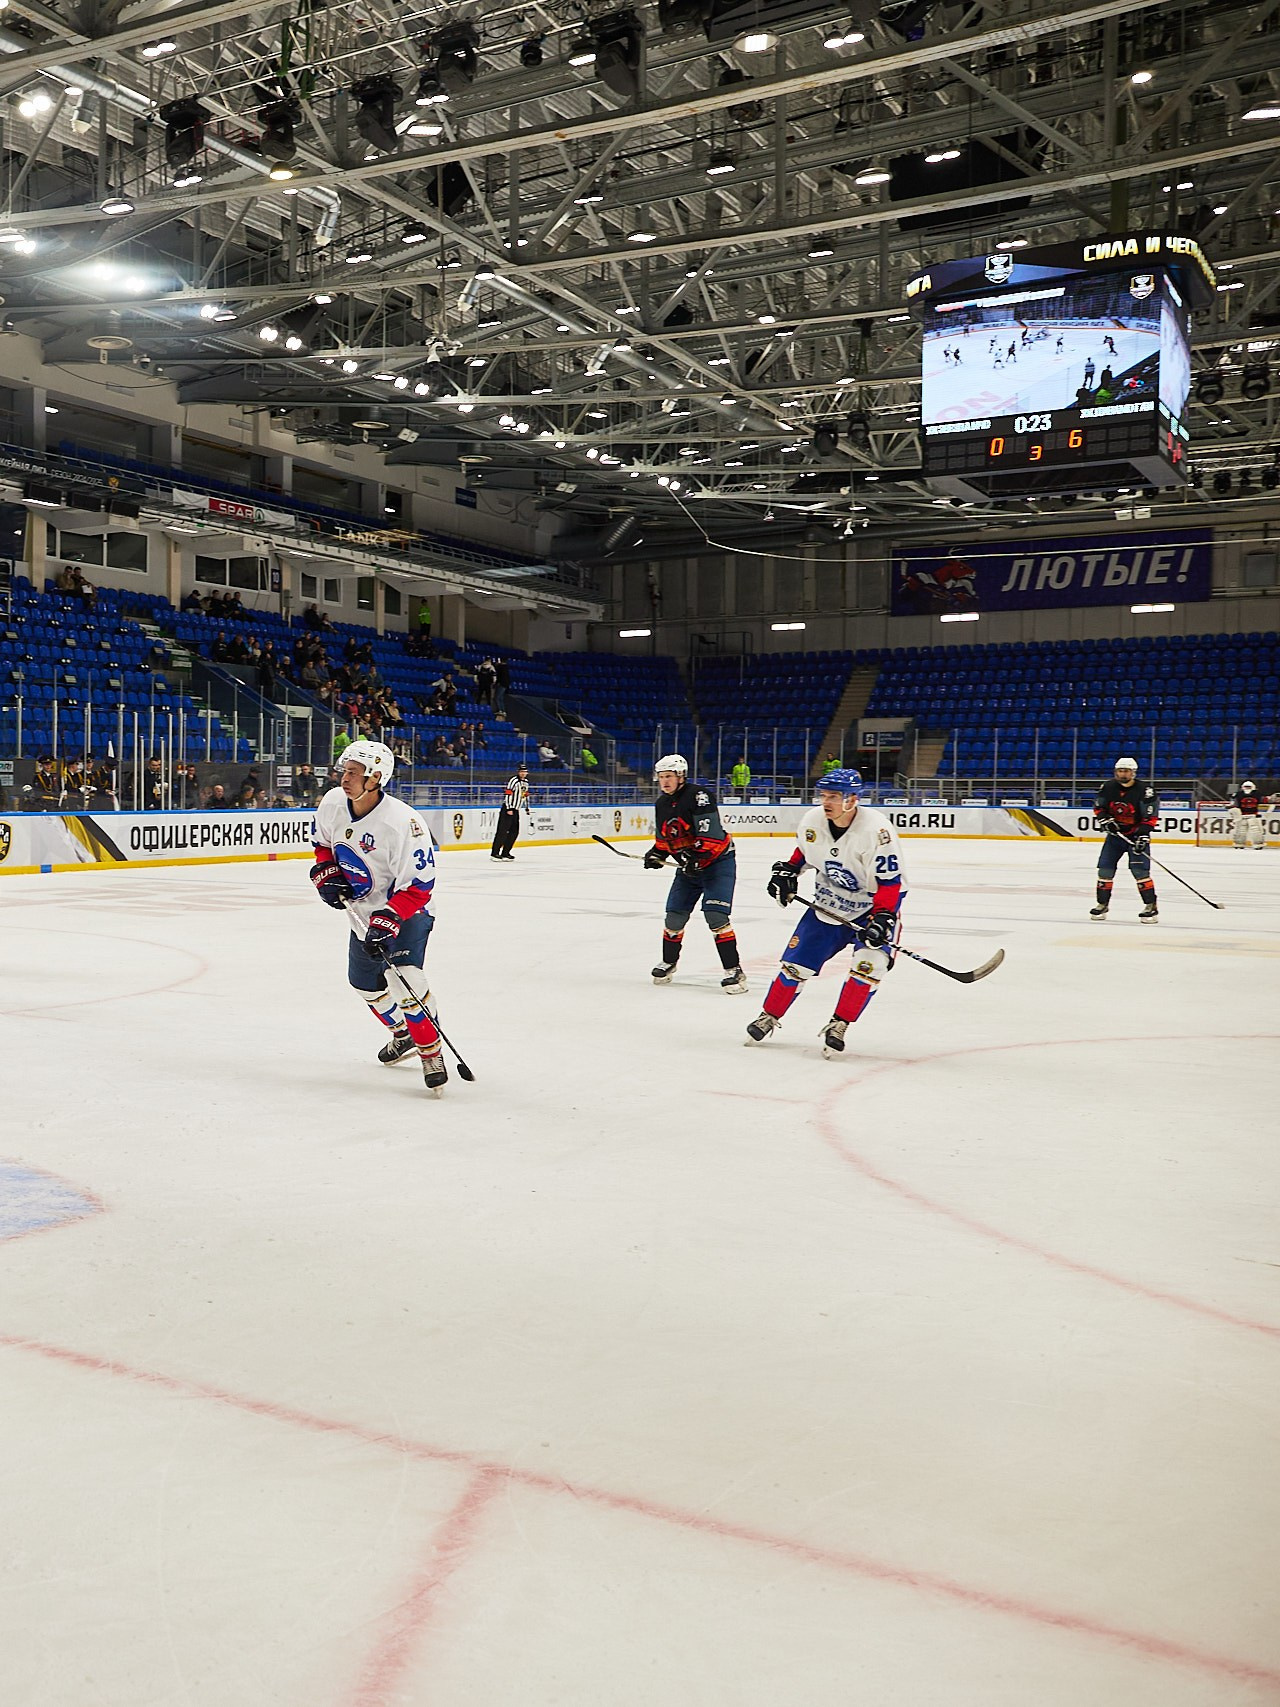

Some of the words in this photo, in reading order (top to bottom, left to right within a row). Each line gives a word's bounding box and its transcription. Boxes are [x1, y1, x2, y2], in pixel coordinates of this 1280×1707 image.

[1083, 238, 1139, 262] СИЛА
[1145, 236, 1161, 253] И
[1014, 414, 1052, 434] 0:23
[990, 437, 1004, 457] 0
[1068, 429, 1083, 448] 6
[1029, 445, 1043, 461] 3
[219, 503, 253, 519] SPAR
[1002, 548, 1194, 593] ЛЮТЫЕ!
[889, 813, 955, 828] IGA.RU
[130, 823, 253, 852] ОФИЦЕРСКАЯ
[260, 821, 310, 845] ХОККЕ
[413, 847, 436, 871] 34
[875, 854, 899, 873] 26
